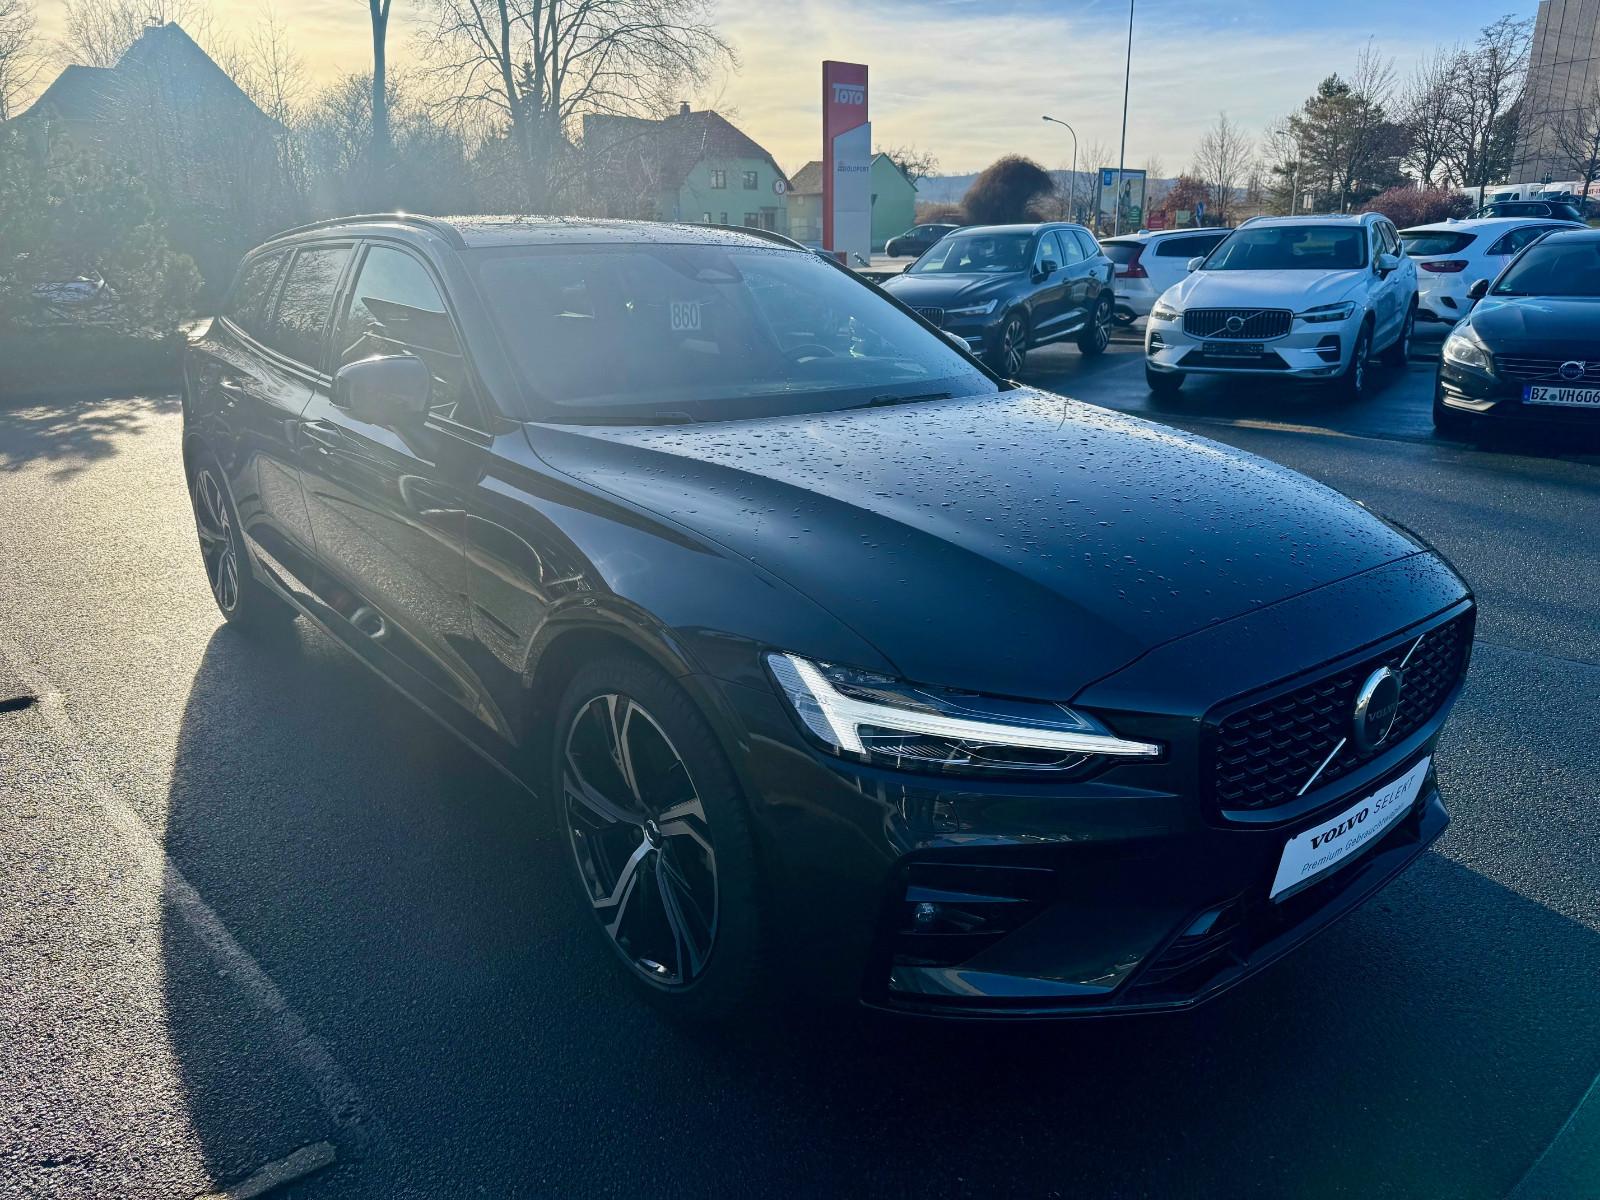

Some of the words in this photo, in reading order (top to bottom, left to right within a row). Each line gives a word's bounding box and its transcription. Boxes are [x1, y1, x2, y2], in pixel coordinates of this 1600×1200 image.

[673, 303, 698, 328] 860
[1531, 388, 1548, 401] BZ
[1310, 808, 1369, 850] VOLVO
[1373, 775, 1415, 814] SELEKT
[1301, 847, 1344, 874] Premium
[1345, 802, 1405, 851] Gebrauchtw
